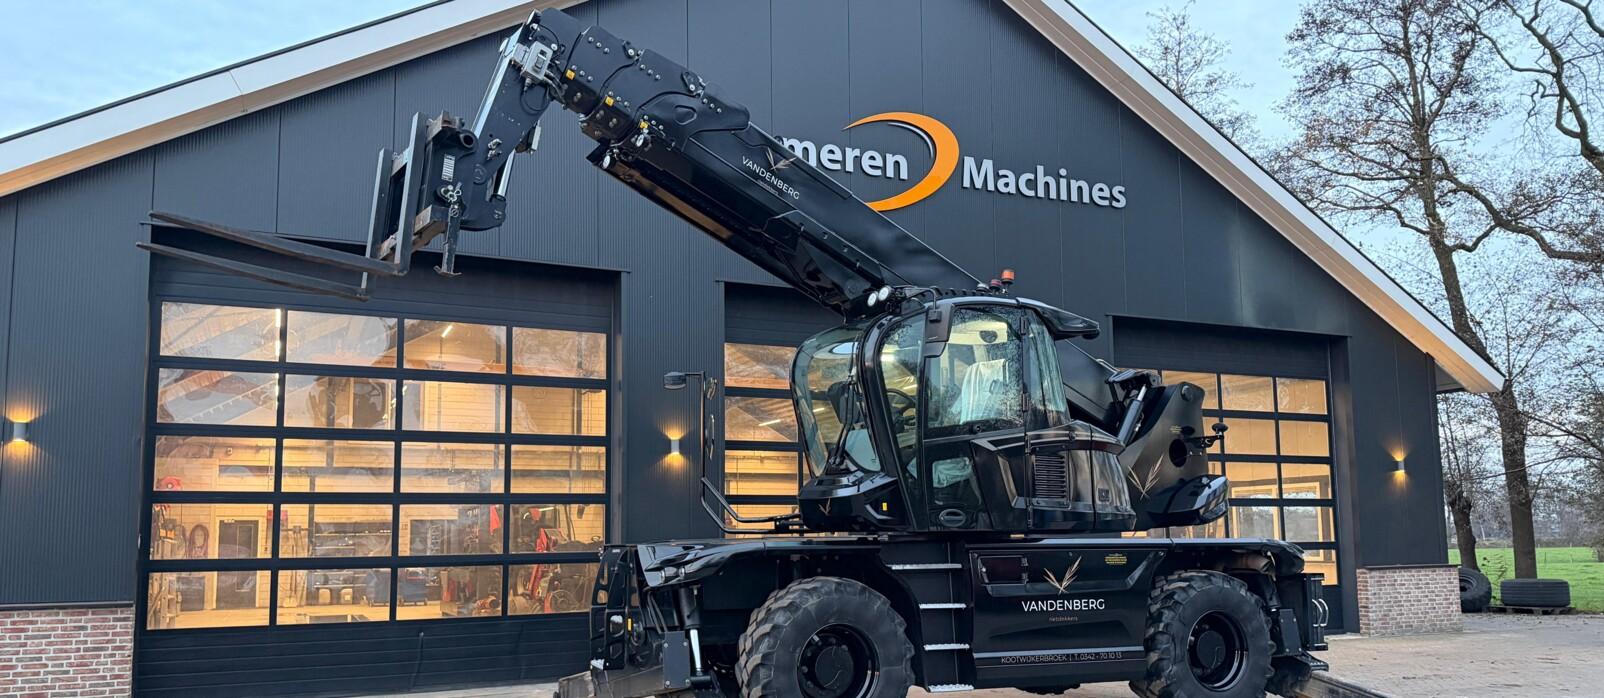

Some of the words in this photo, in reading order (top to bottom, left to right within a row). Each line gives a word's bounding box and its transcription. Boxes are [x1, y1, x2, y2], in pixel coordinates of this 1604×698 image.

[742, 155, 800, 200] VANDENBERG
[962, 156, 1127, 208] Machines
[1021, 599, 1106, 612] VANDENBERG
